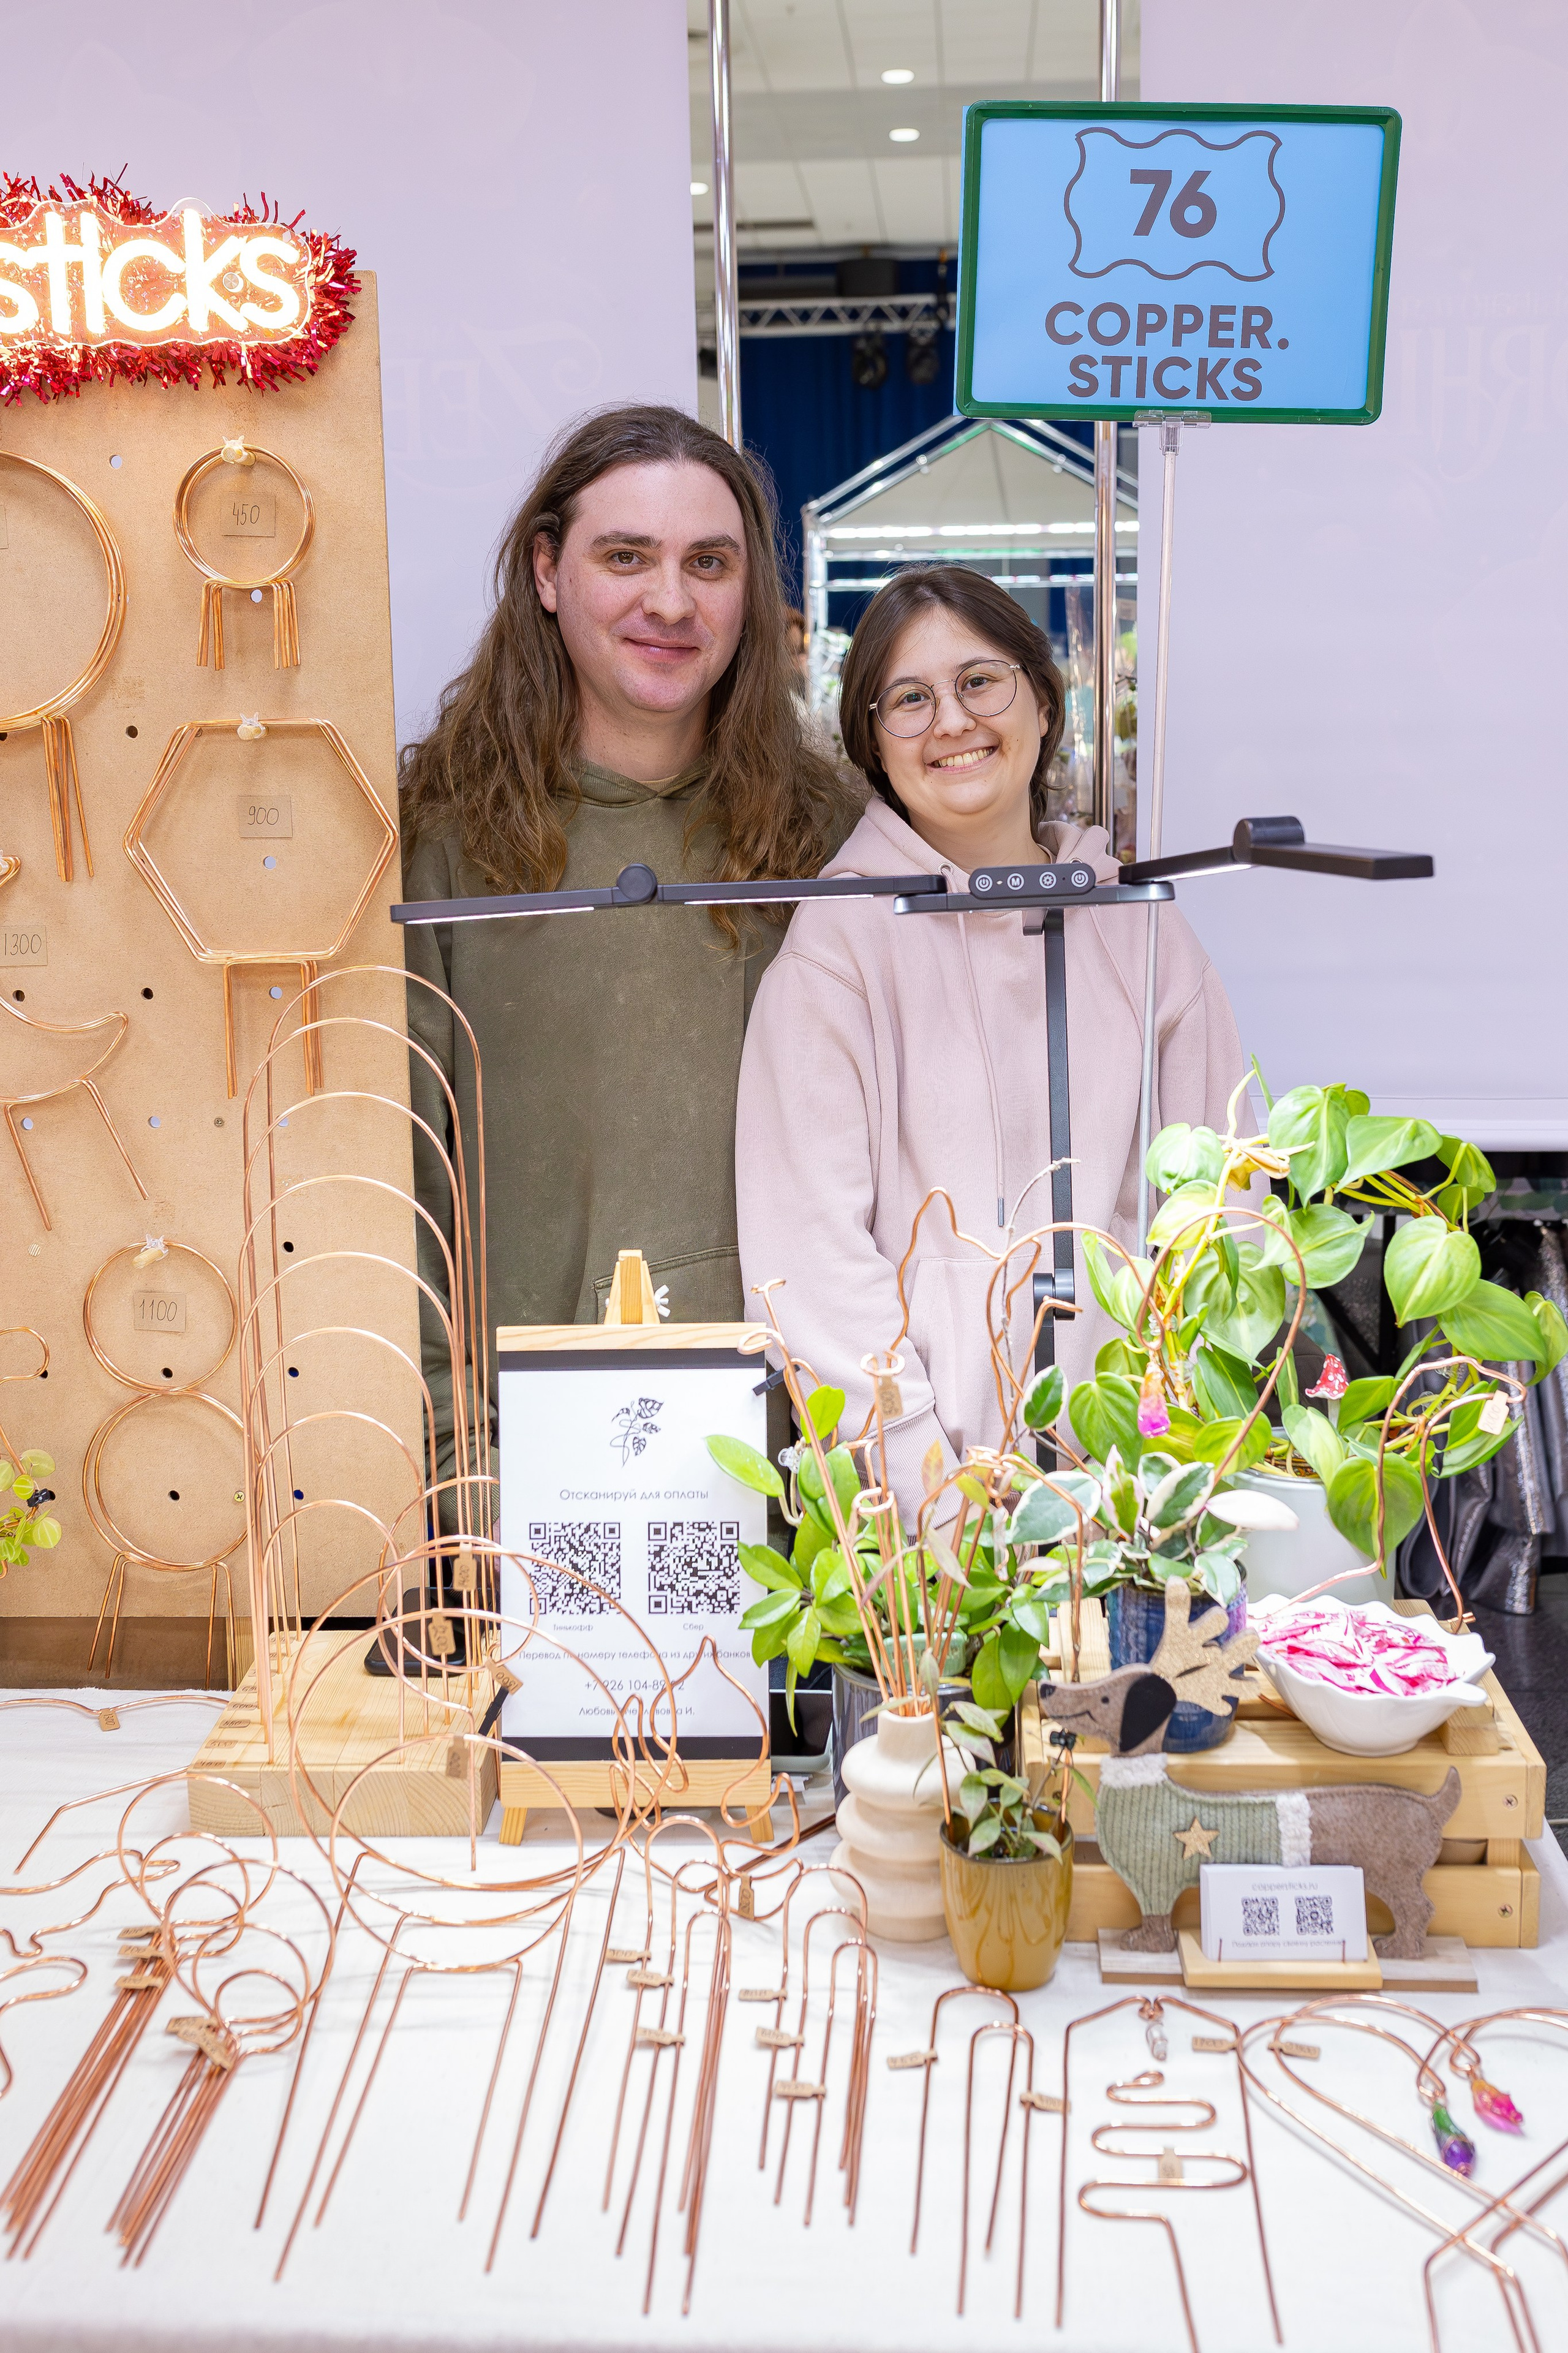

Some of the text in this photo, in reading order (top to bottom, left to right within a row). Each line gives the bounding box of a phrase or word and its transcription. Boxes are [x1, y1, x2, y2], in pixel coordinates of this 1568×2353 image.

[1129, 169, 1218, 238] 76
[1044, 301, 1289, 350] COPPER.
[1066, 354, 1264, 402] STICKS
[233, 502, 260, 526] 450
[247, 806, 279, 826] 900
[1011, 877, 1020, 886] M
[4, 933, 42, 956] 1300
[139, 1298, 178, 1322] 1100
[559, 1488, 709, 1501] Отсканируй для оплаты
[519, 1650, 561, 1661] Перевод
[578, 1651, 616, 1661] номеру
[717, 1649, 751, 1659] банков
[585, 1680, 598, 1691] +7
